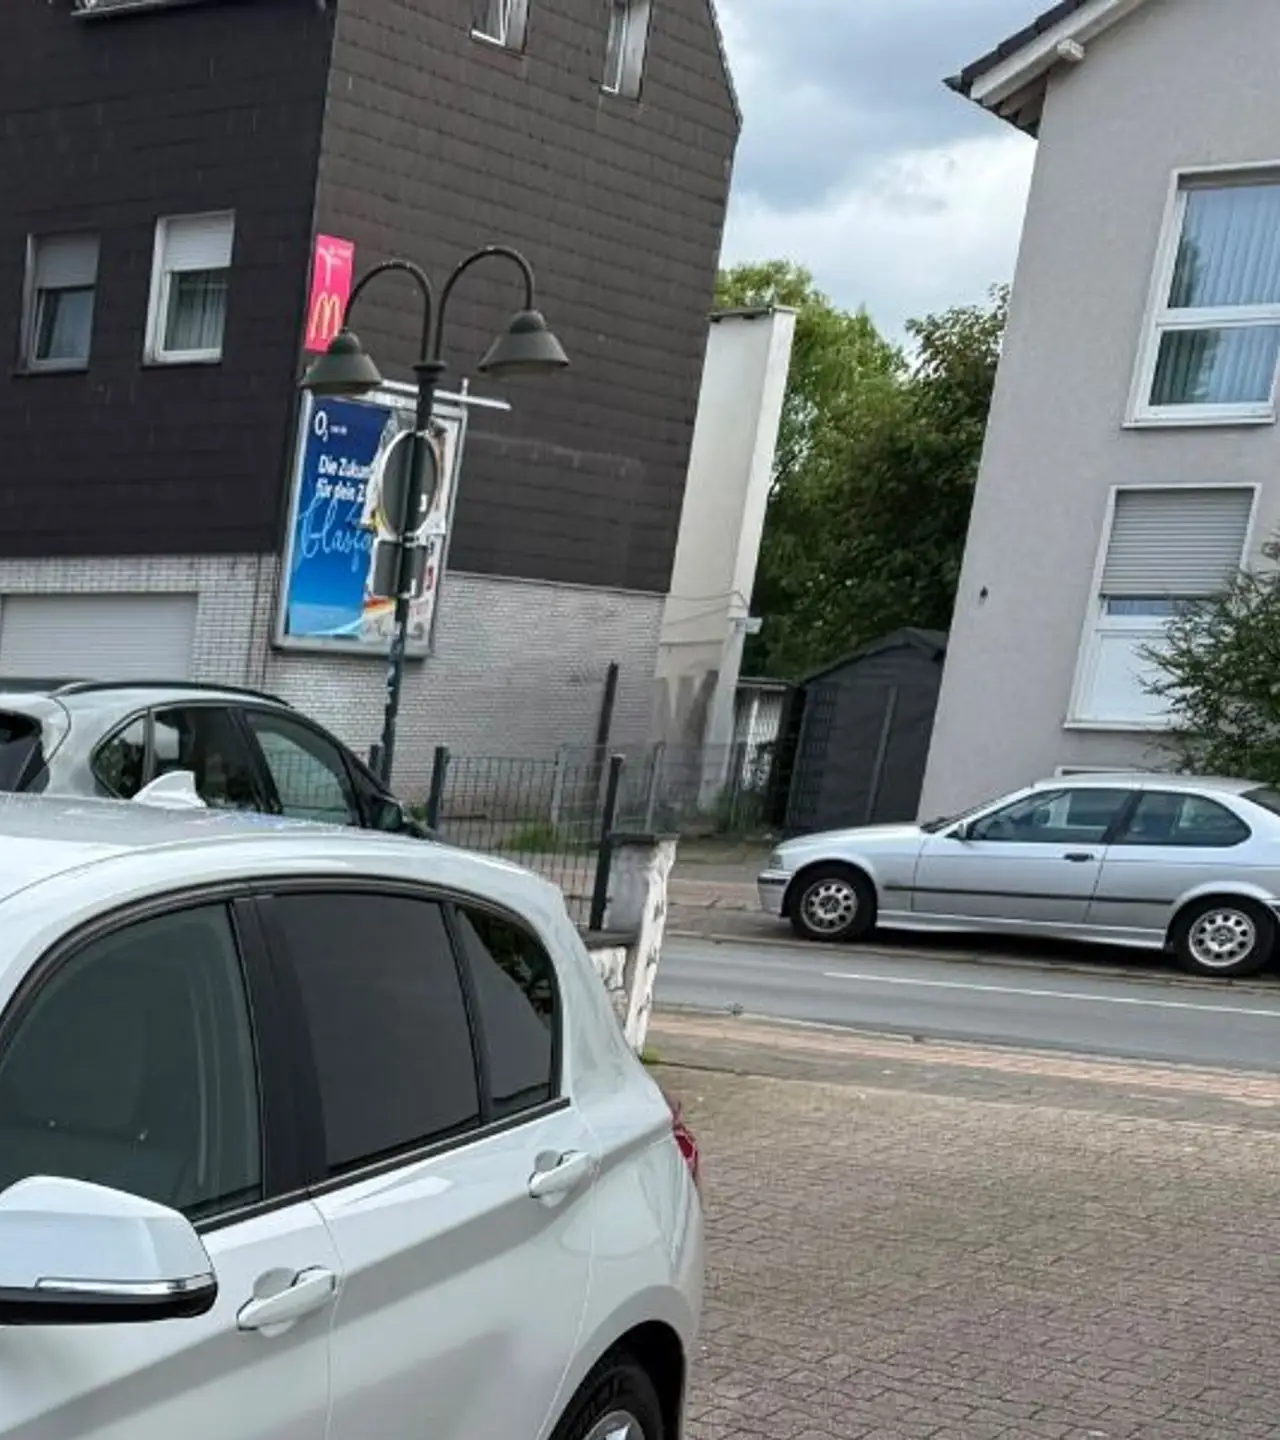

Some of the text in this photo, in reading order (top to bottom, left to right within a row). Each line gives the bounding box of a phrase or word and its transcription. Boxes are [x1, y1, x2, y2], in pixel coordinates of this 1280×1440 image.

[318, 454, 337, 476] Die
[316, 477, 333, 499] für
[334, 480, 355, 501] dein
